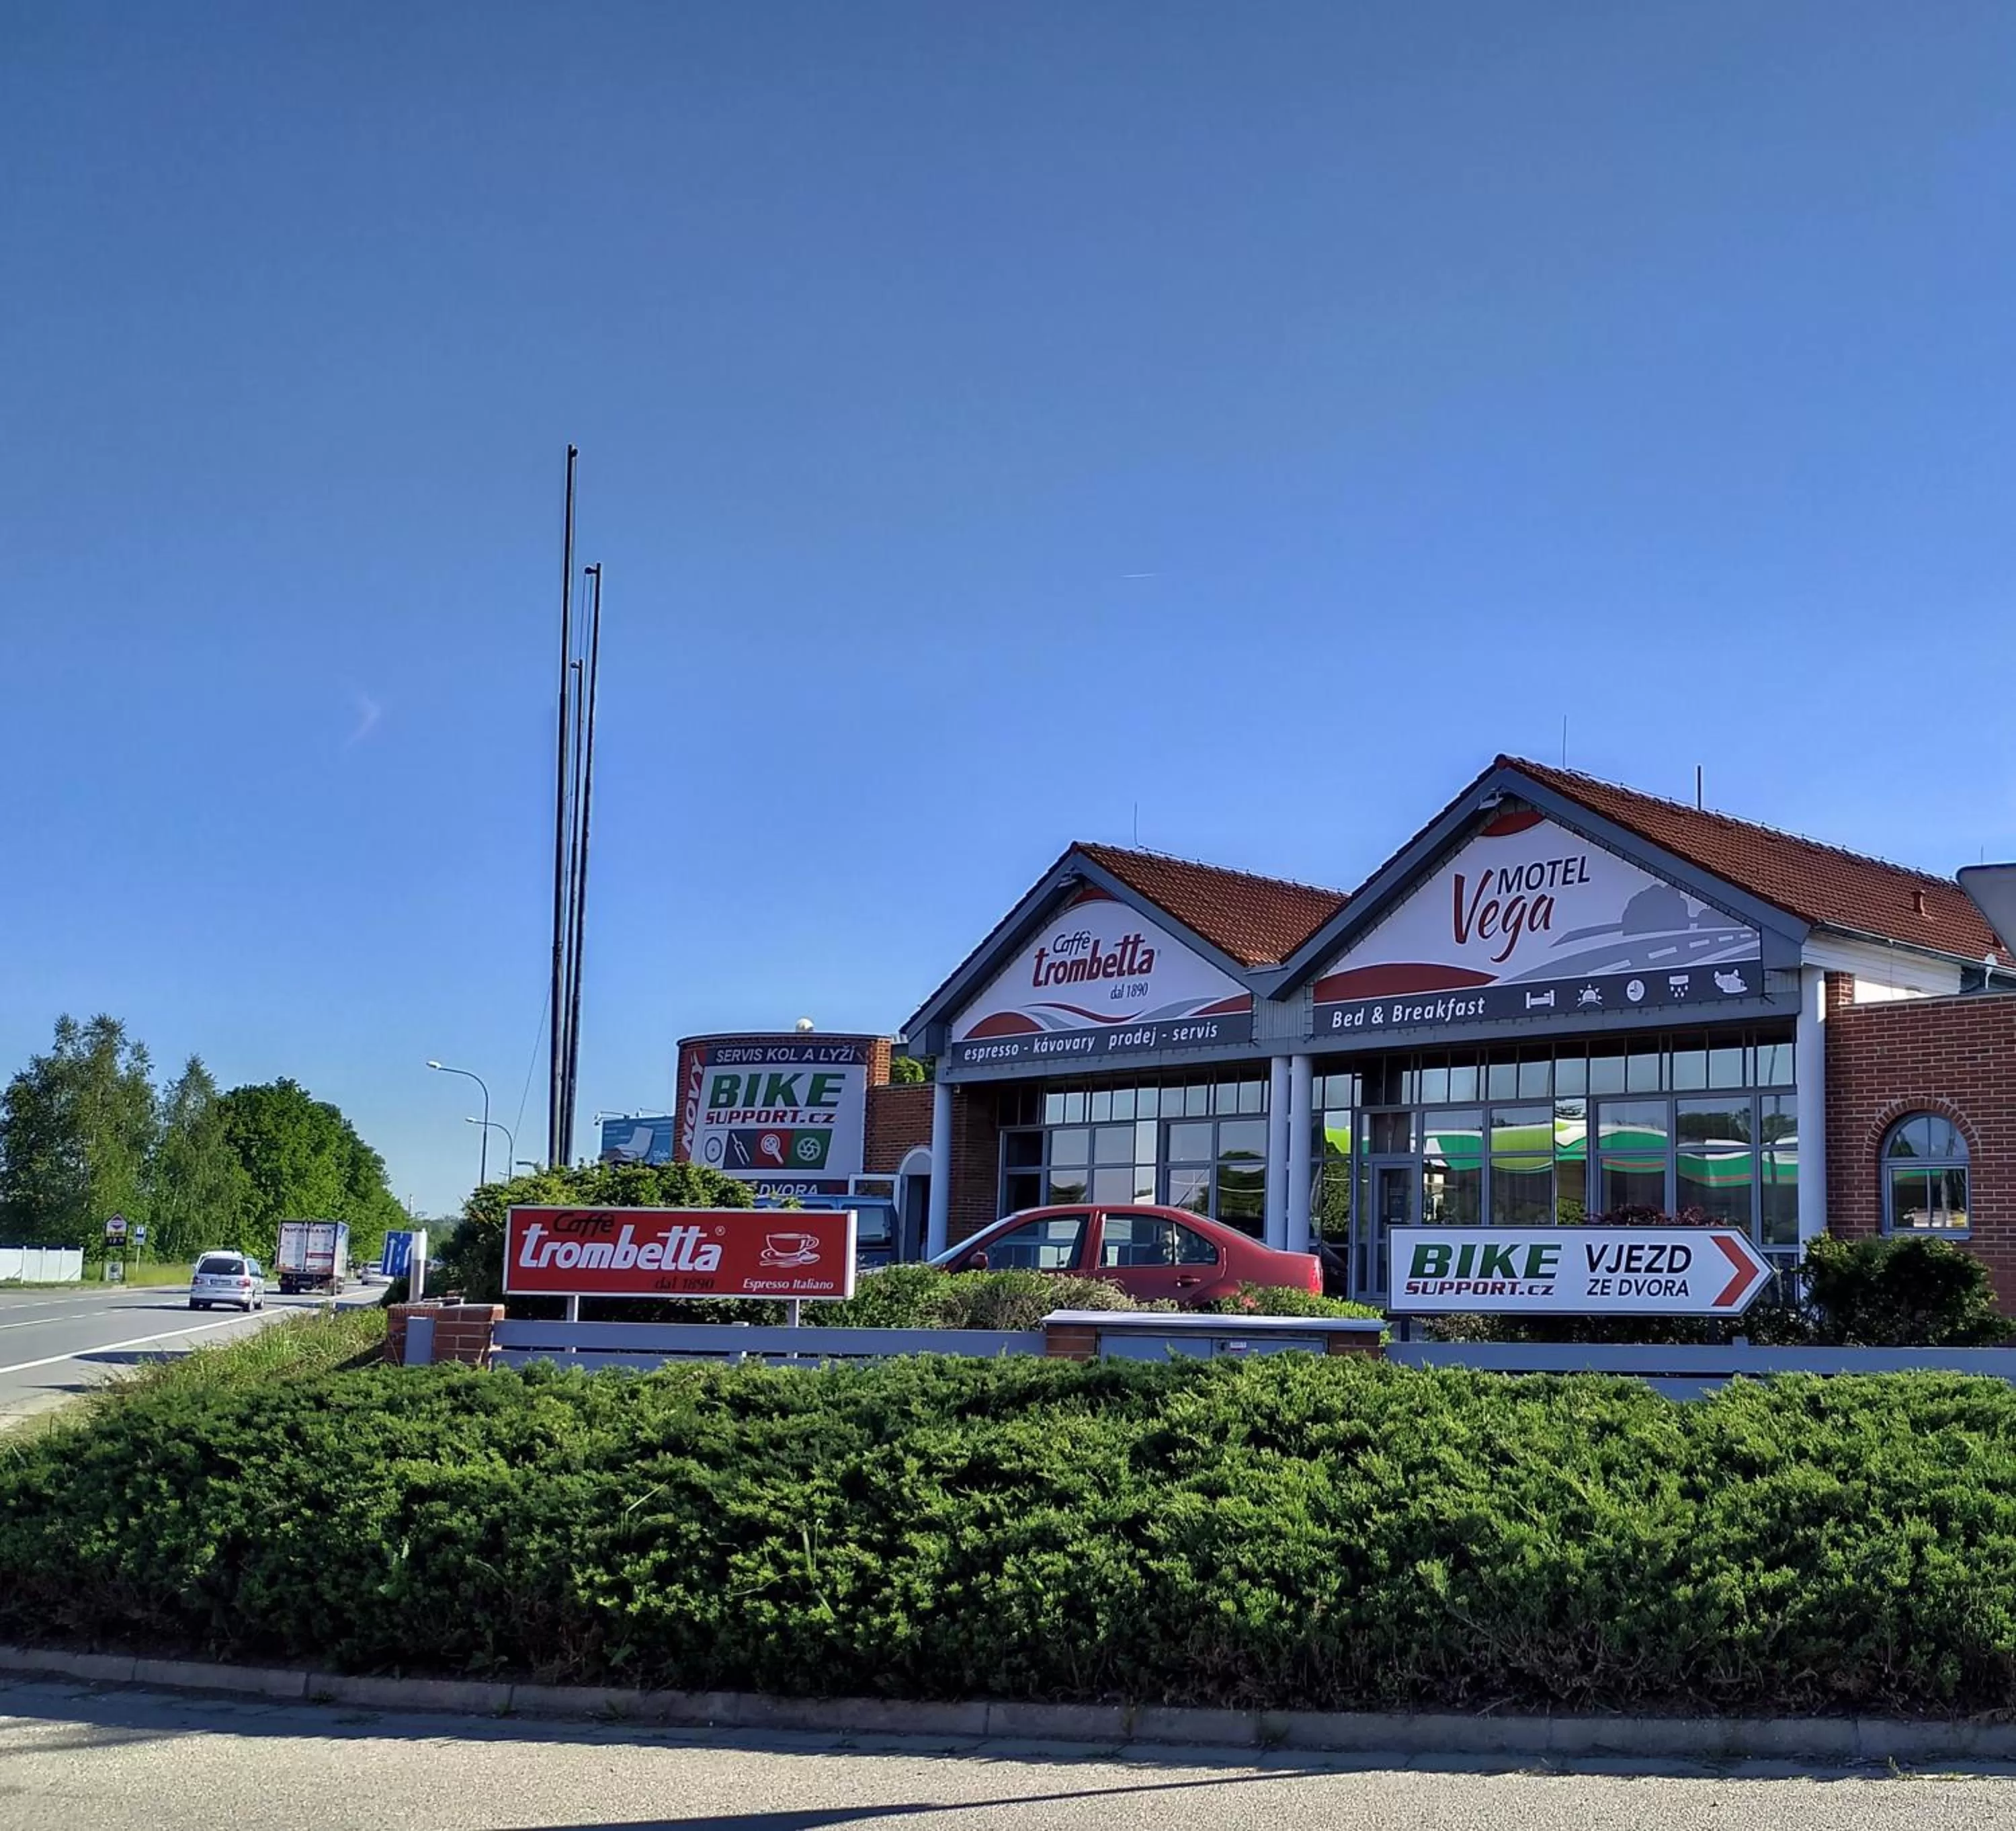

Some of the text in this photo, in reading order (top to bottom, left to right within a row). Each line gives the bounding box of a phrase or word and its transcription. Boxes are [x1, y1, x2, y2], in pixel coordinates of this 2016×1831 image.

[1497, 855, 1591, 896] MOTEL
[1452, 868, 1555, 963] Vega
[1052, 930, 1092, 957] Caffè
[1033, 933, 1156, 987] trombetta
[1110, 981, 1149, 1000] dal 1890
[1332, 997, 1486, 1028] Bed & Breakfast
[716, 1045, 855, 1063] SERVIS KOL A LYŽÍ
[964, 1043, 1019, 1062] espresso
[1033, 1034, 1095, 1054] kávovary
[1108, 1027, 1157, 1050] prodej
[1172, 1022, 1218, 1041] servis
[682, 1051, 704, 1153] NOVÝ
[708, 1073, 846, 1108] BIKE
[759, 1184, 818, 1195] DVORA
[553, 1212, 615, 1235] Caffè
[518, 1223, 724, 1272] trombetta
[1409, 1244, 1562, 1279] BIKE
[1585, 1244, 1692, 1274] VJEZD
[655, 1277, 715, 1290] dal 1890
[743, 1278, 834, 1291] Espresso Italiano
[1586, 1278, 1690, 1297] ZE DVORA
